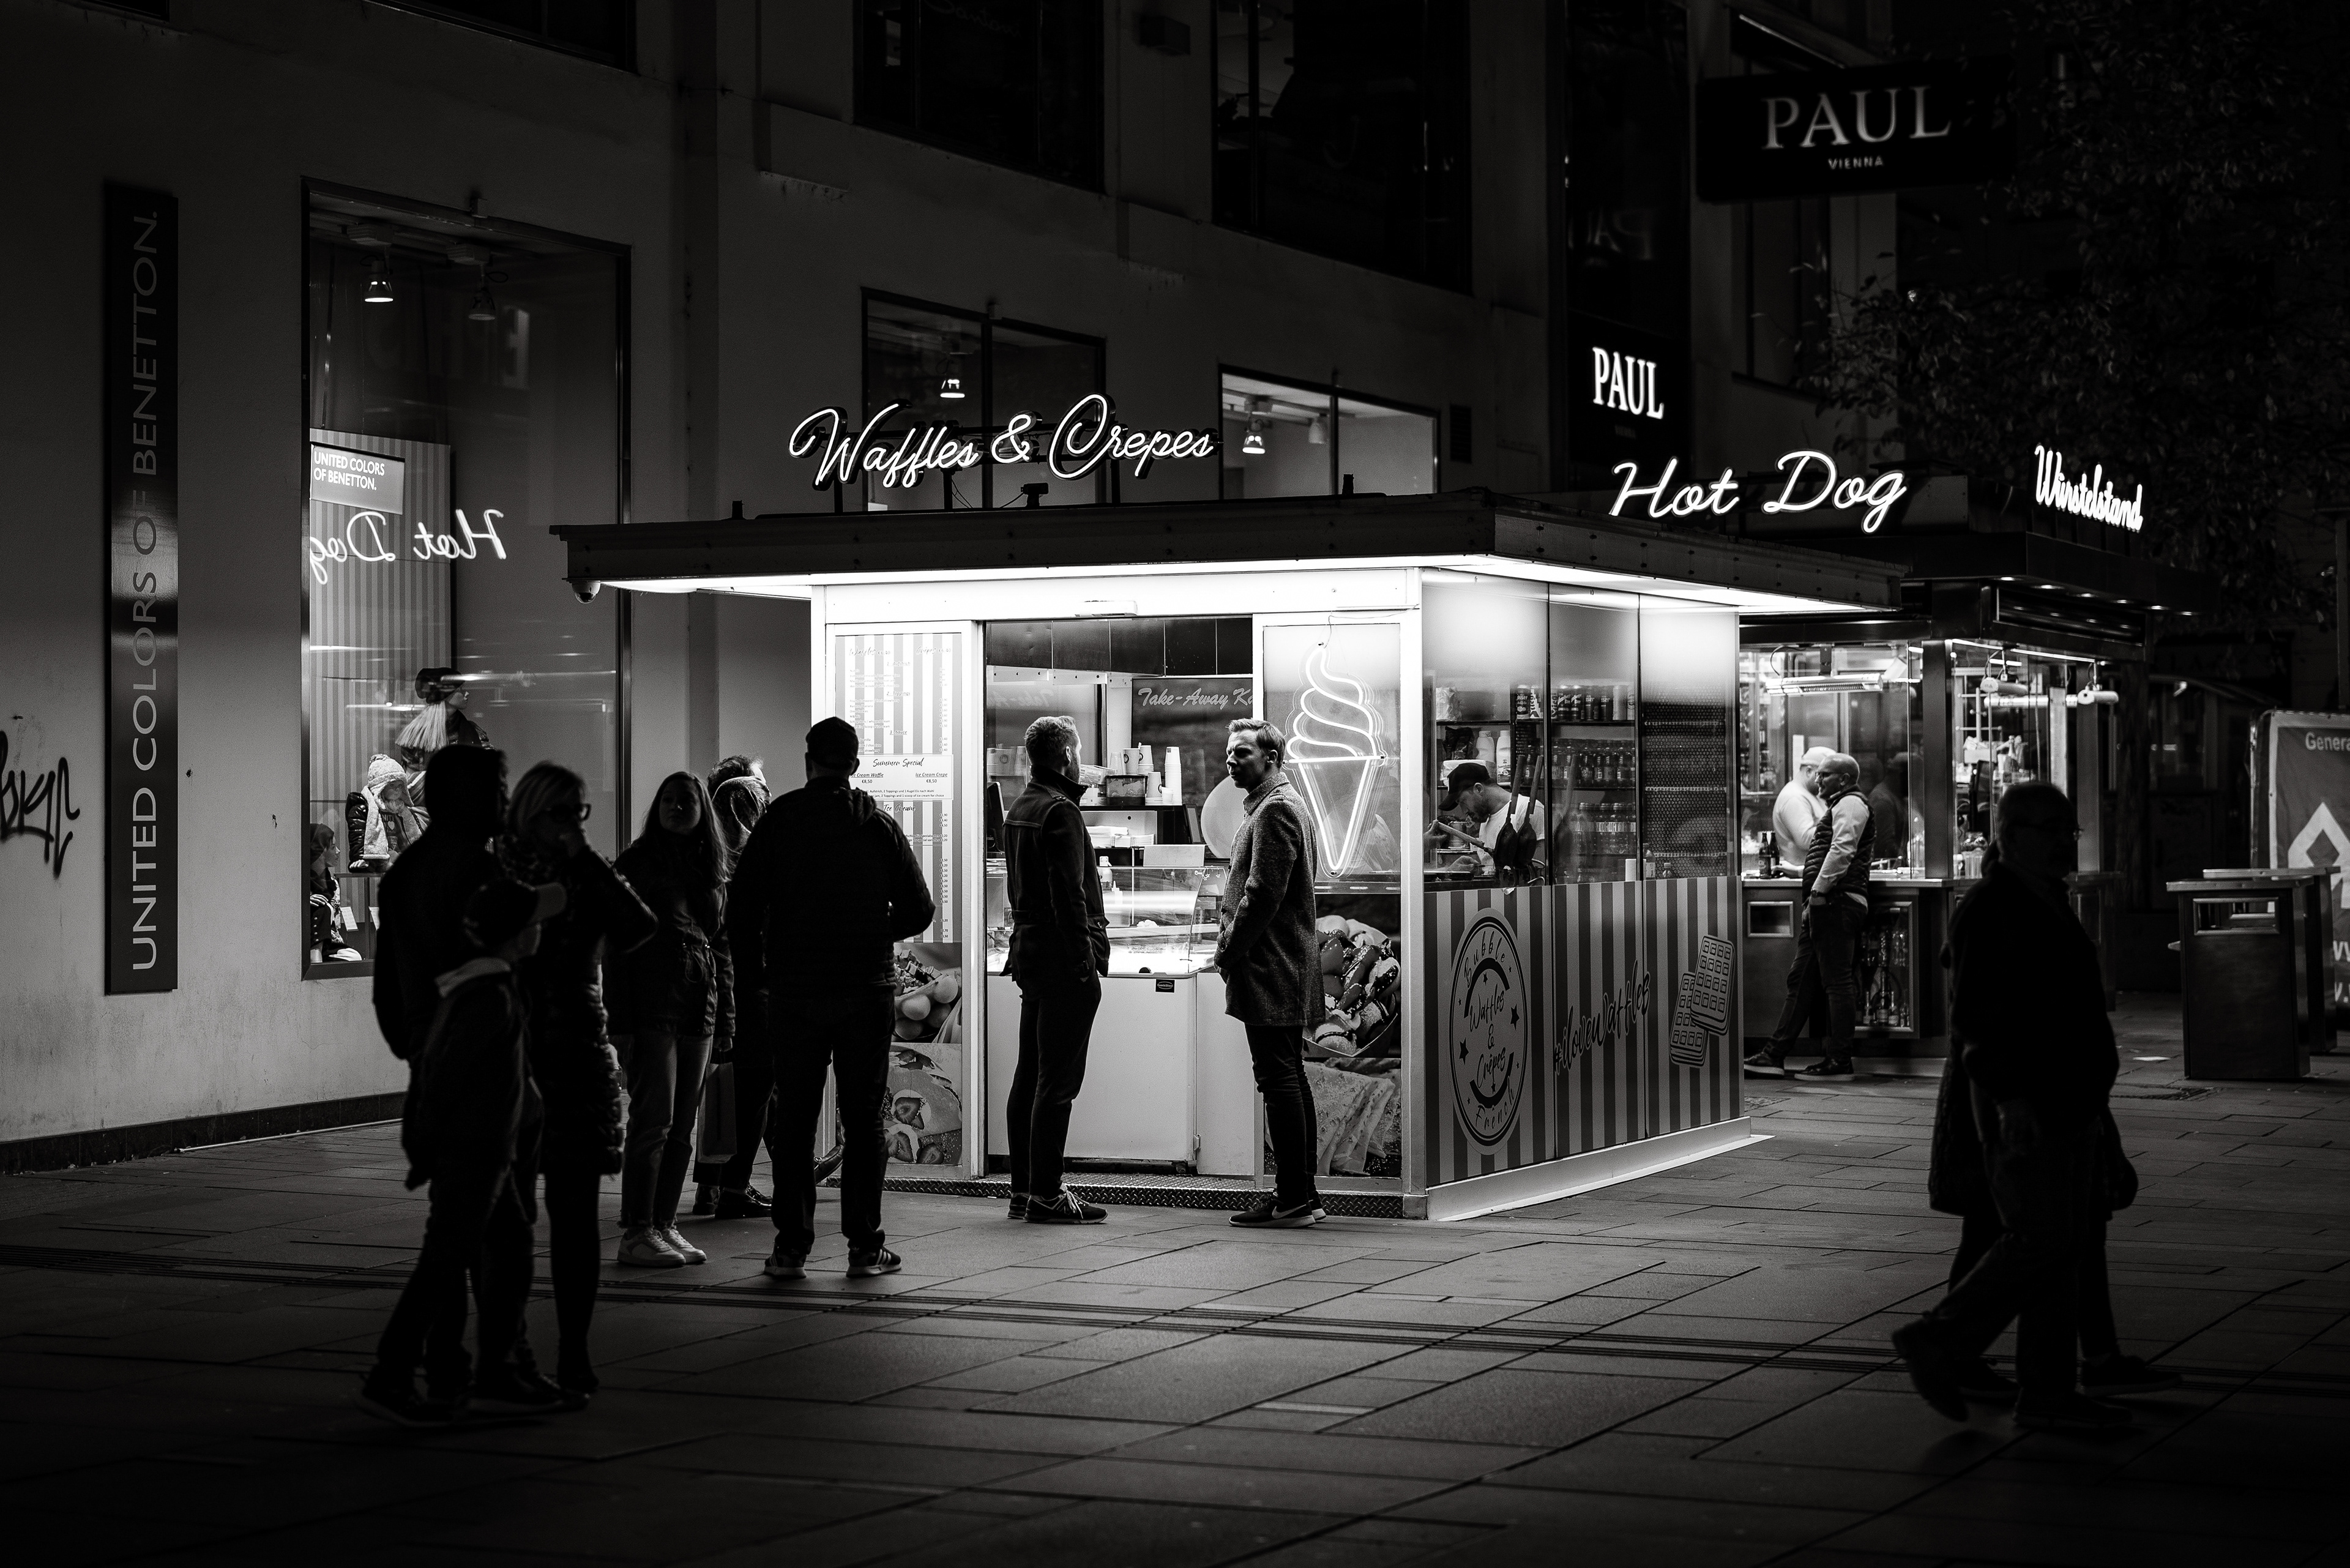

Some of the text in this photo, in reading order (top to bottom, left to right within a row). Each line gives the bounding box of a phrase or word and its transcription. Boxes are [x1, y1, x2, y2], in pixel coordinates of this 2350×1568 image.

[1759, 84, 1953, 151] PAUL
[1827, 154, 1885, 171] VIENNA
[1592, 346, 1665, 419] PAUL
[314, 450, 385, 476] UNITED COLORS
[789, 394, 1214, 488] Waffles & Crepes
[313, 468, 378, 491] OF BENETTON.
[1608, 449, 1908, 534] Hot Dog
[132, 211, 158, 970] UNITED COLORS OF BENETTON.
[1138, 687, 1228, 710] Take-Away
[873, 757, 925, 767] Summer Special
[1464, 930, 1505, 988] Bubble
[1469, 983, 1505, 1032] Waffles
